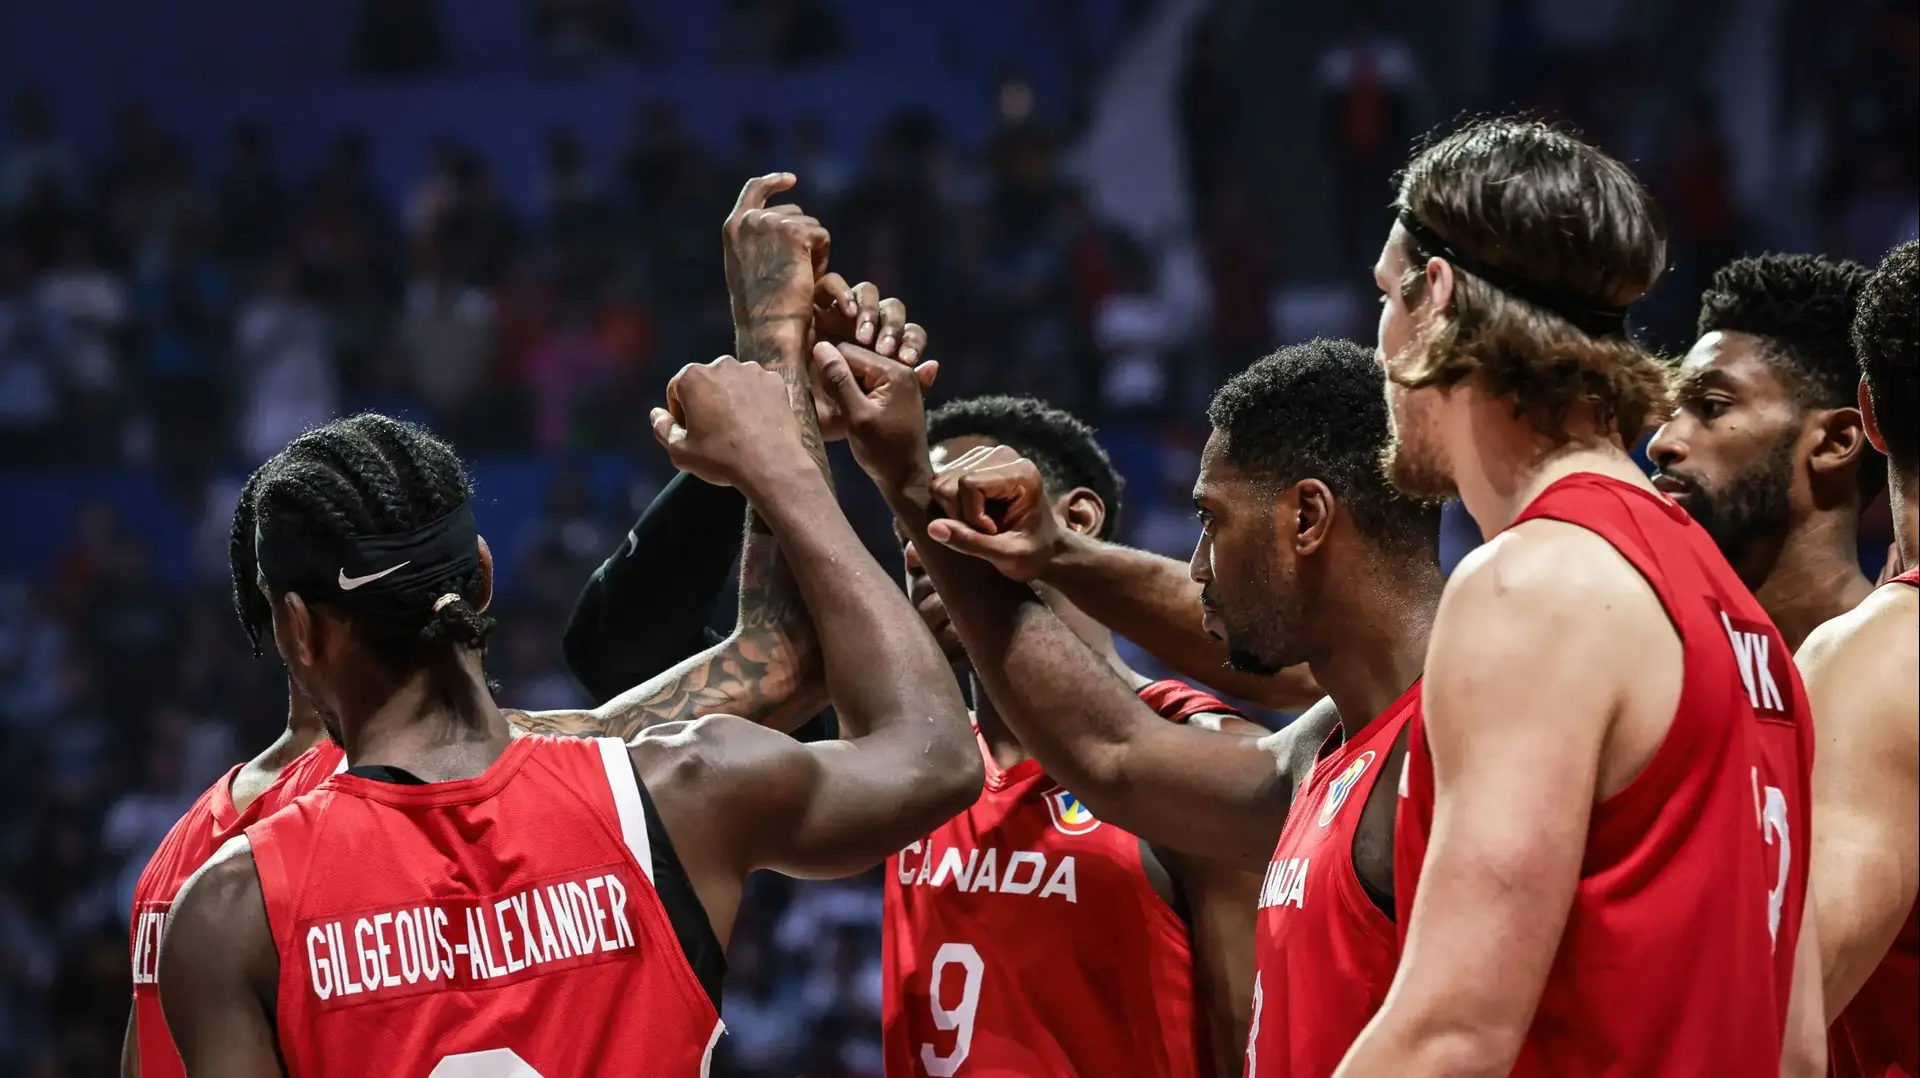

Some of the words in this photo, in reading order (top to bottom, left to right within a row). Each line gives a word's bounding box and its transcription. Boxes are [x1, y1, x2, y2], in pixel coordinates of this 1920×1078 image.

[898, 838, 1077, 903] CANADA
[306, 874, 635, 1001] GILGEOUS-ALEXANDER
[920, 942, 985, 1077] 9
